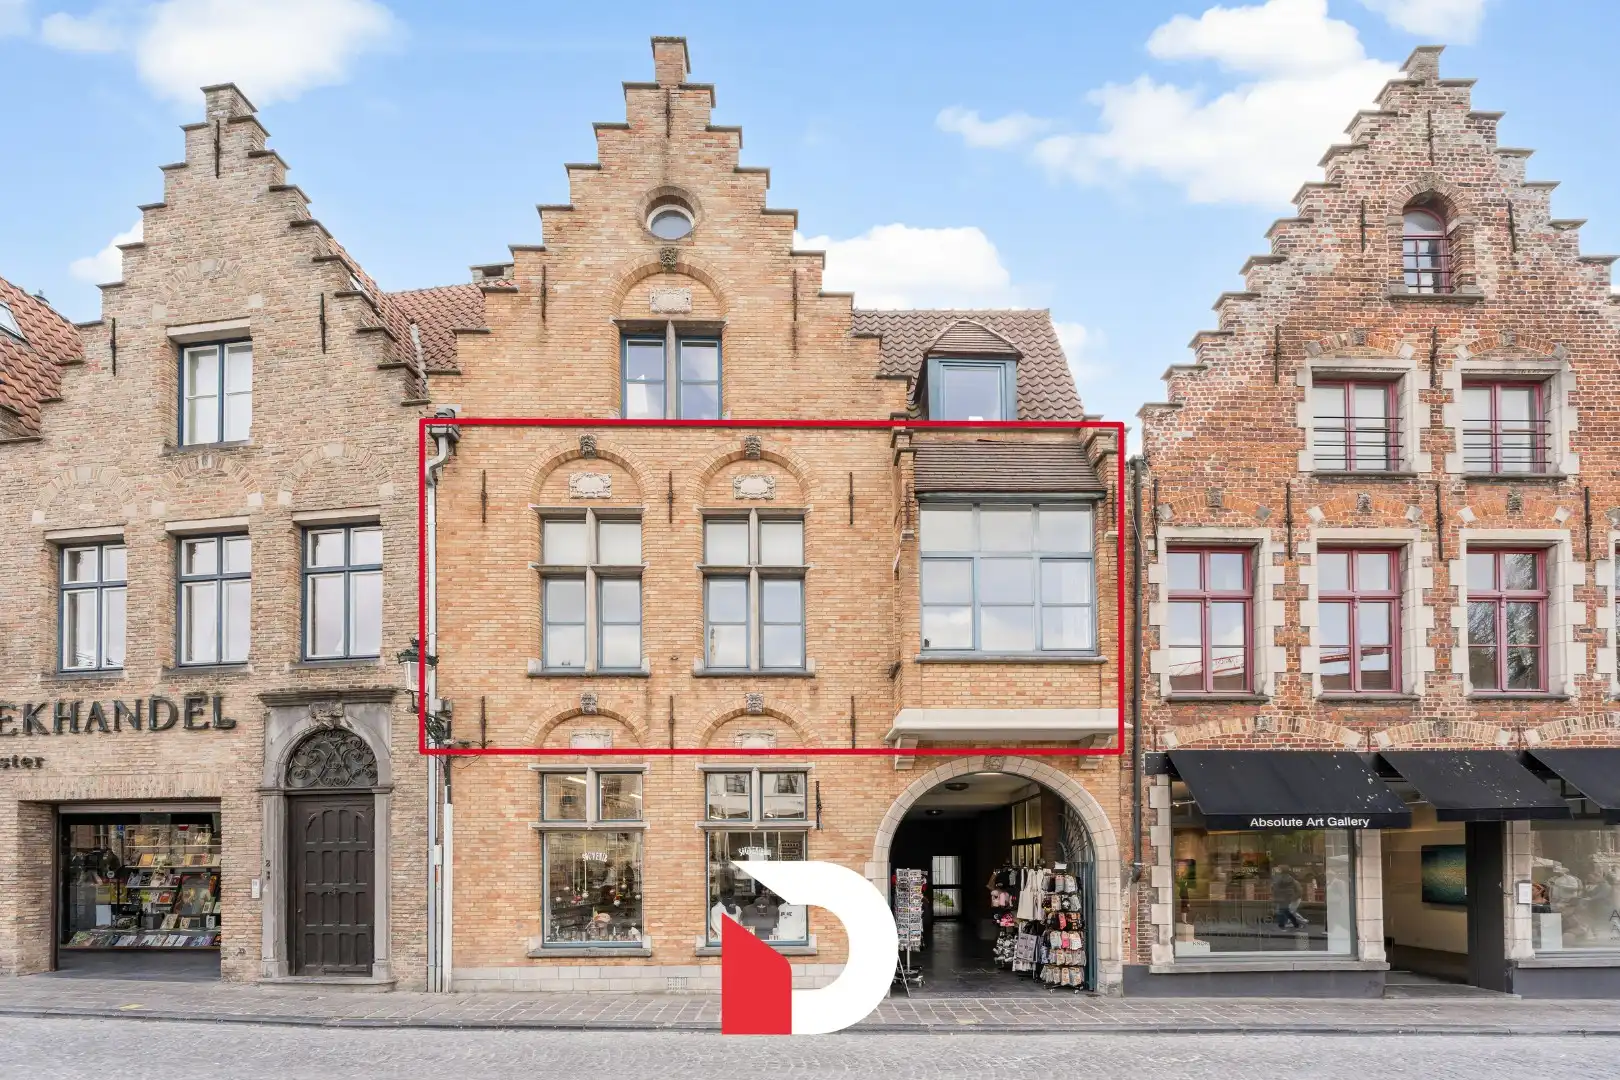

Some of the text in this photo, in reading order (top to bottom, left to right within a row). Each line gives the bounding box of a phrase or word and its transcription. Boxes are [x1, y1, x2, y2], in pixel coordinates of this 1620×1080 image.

[0, 692, 237, 736] EKHANDEL
[1250, 817, 1370, 828] Absolute Art Gallery
